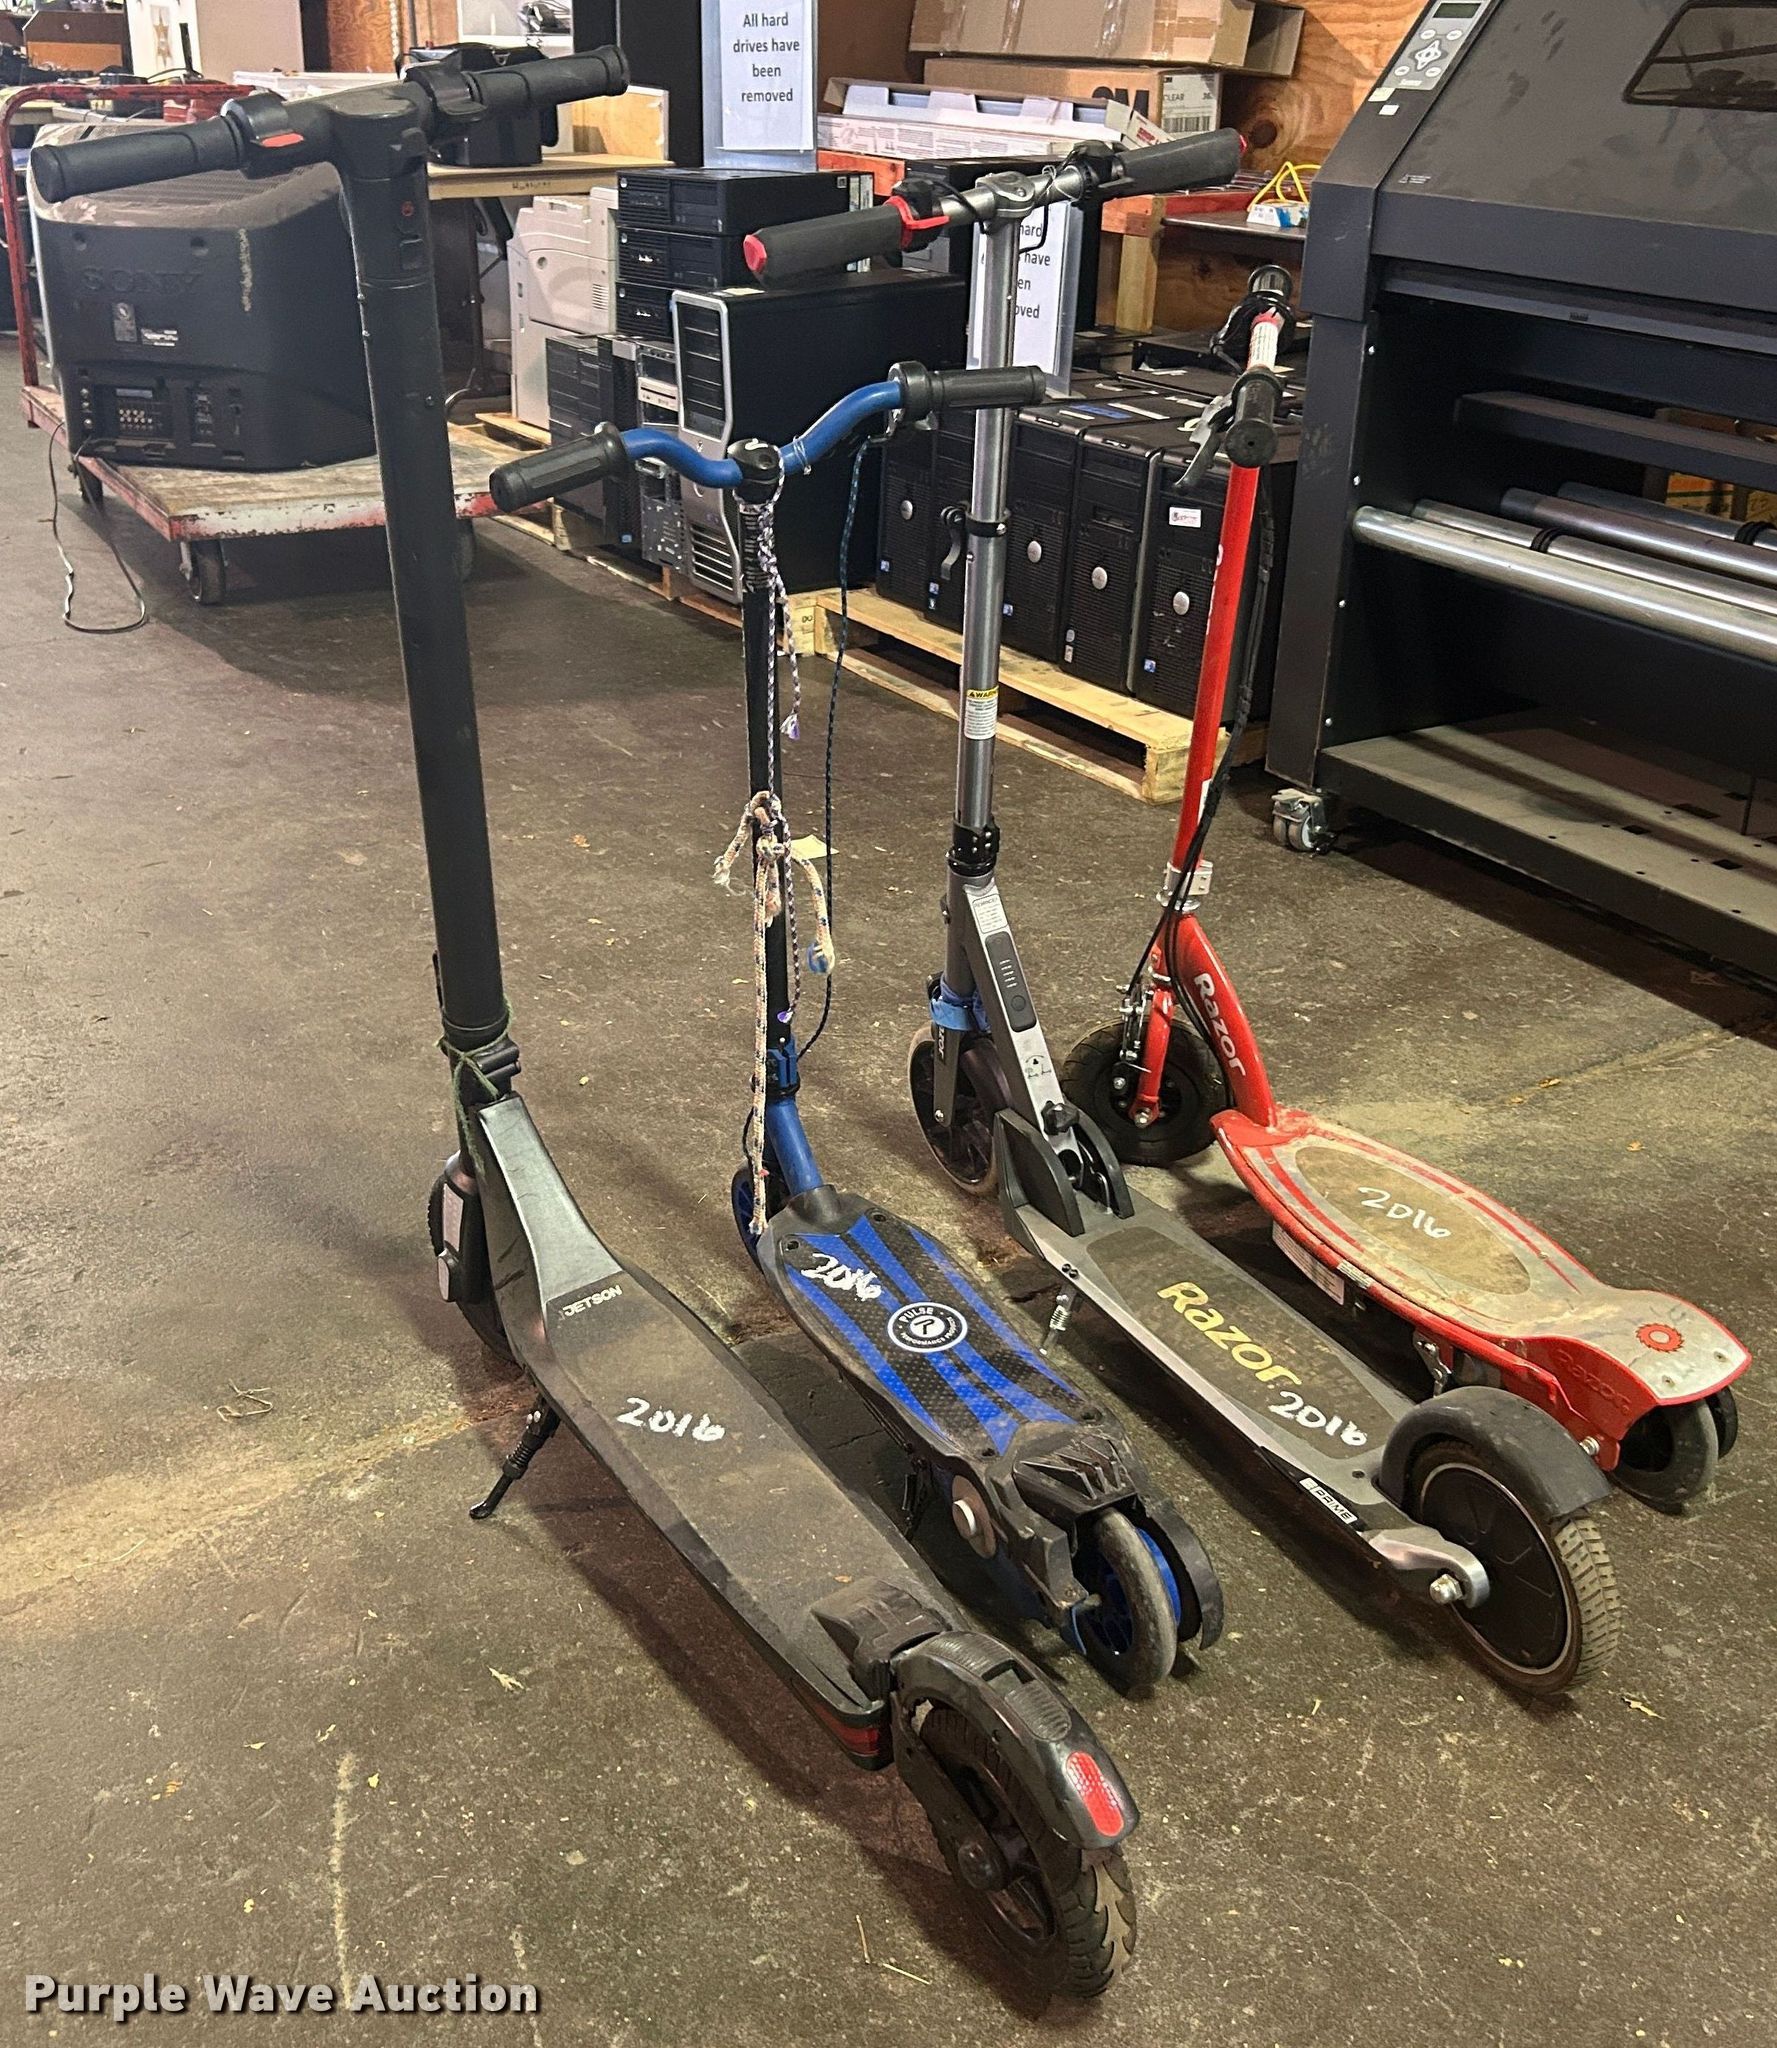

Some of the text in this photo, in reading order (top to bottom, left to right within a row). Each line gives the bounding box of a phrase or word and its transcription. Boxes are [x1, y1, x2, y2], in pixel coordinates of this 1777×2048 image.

[743, 12, 789, 28] All hard
[733, 37, 801, 53] drives have
[752, 63, 782, 78] been
[741, 87, 794, 102] removed
[1023, 251, 1051, 267] have
[1193, 971, 1247, 1078] Razor
[1358, 1186, 1452, 1239] 2016
[800, 1252, 883, 1301] 2016
[562, 1284, 624, 1318] JETSON
[898, 1306, 934, 1323] PULSE
[1156, 1281, 1302, 1386] Razor
[616, 1397, 726, 1442] 2016
[1268, 1390, 1369, 1447] 2016
[1315, 1488, 1353, 1521] PRIME
